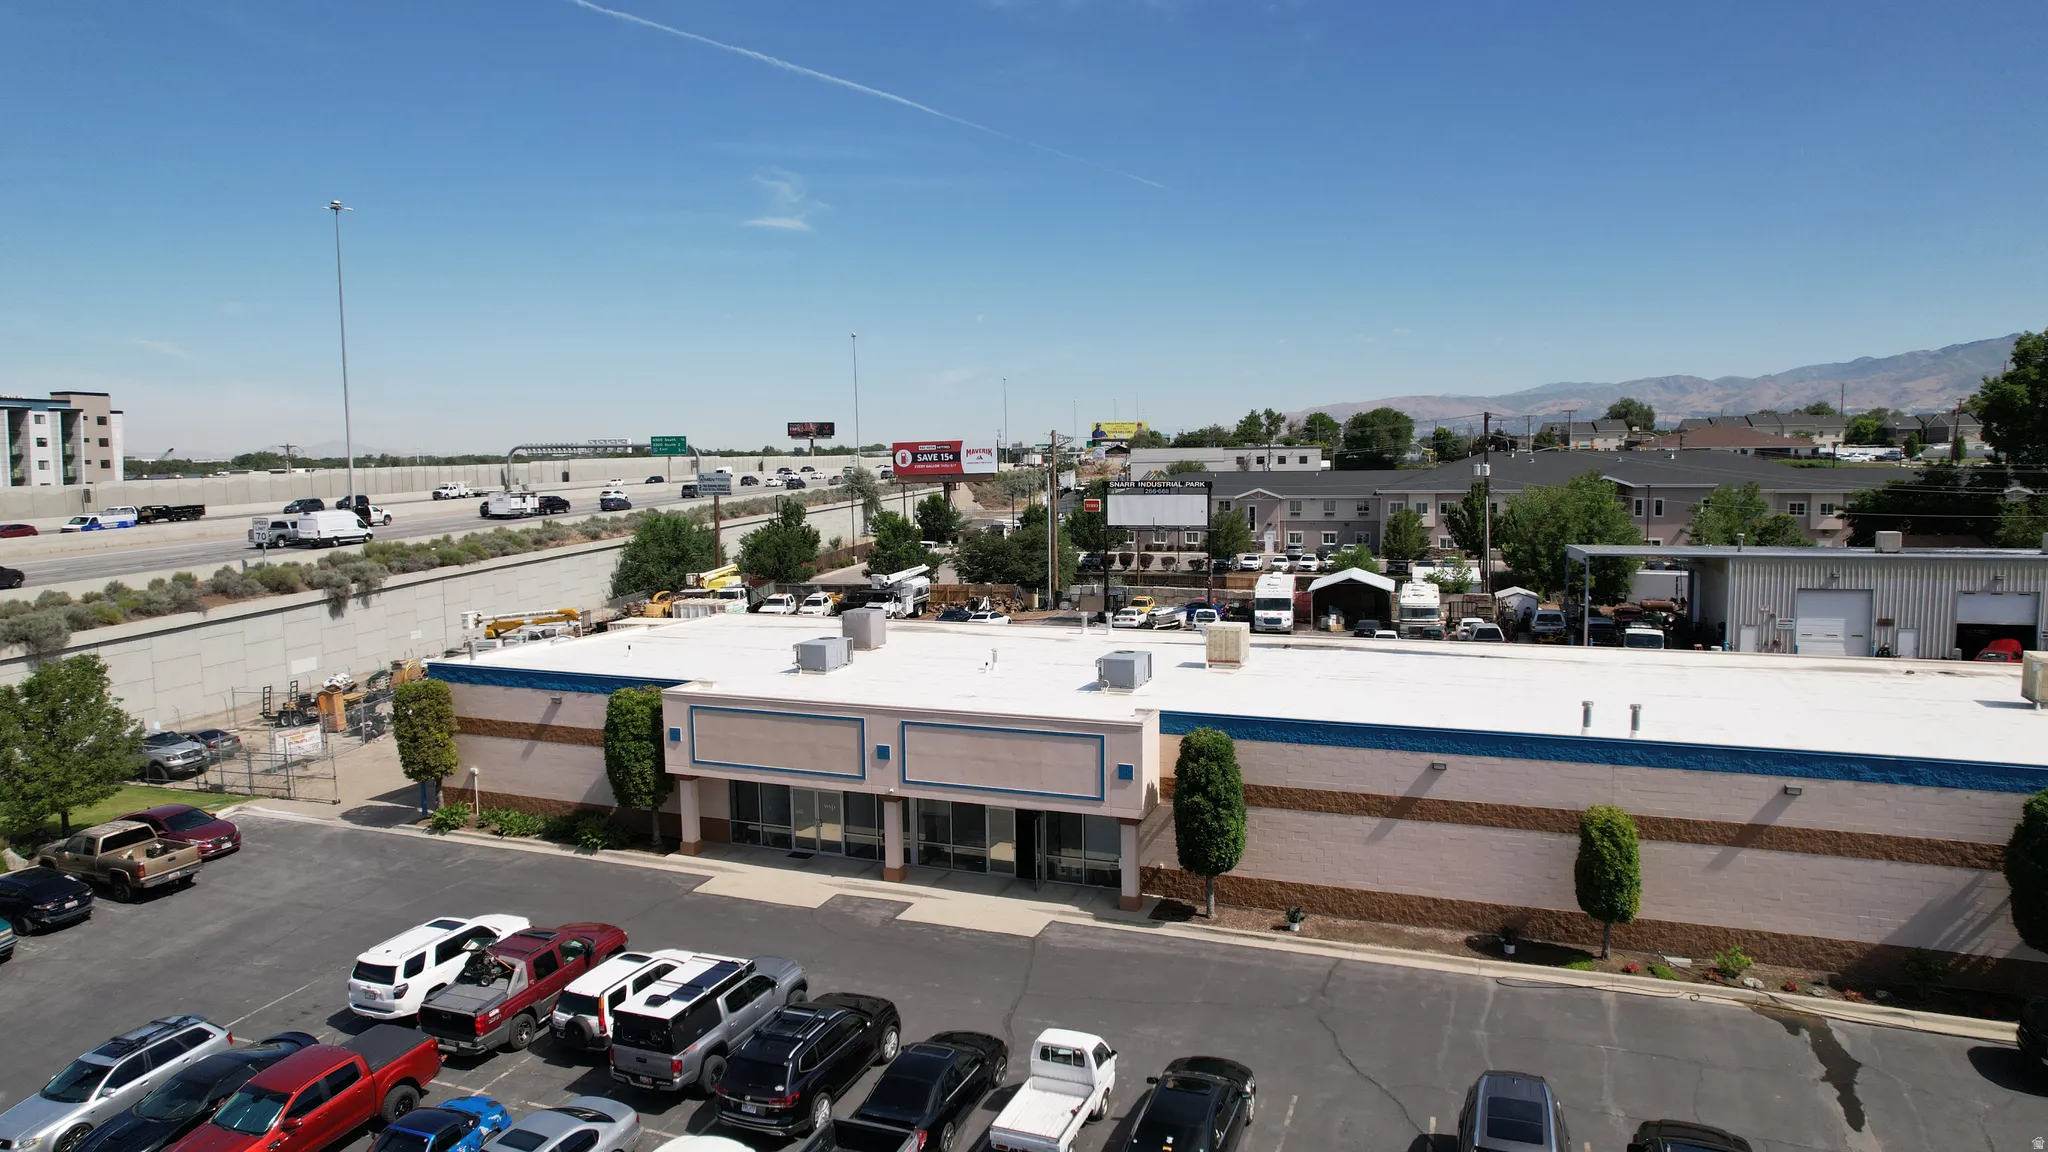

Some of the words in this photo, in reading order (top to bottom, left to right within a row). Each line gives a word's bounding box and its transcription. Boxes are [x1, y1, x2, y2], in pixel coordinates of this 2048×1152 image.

[917, 453, 938, 462] SAVE
[940, 453, 954, 461] 15¢
[966, 448, 993, 458] MAVERIK
[256, 532, 267, 541] 70
